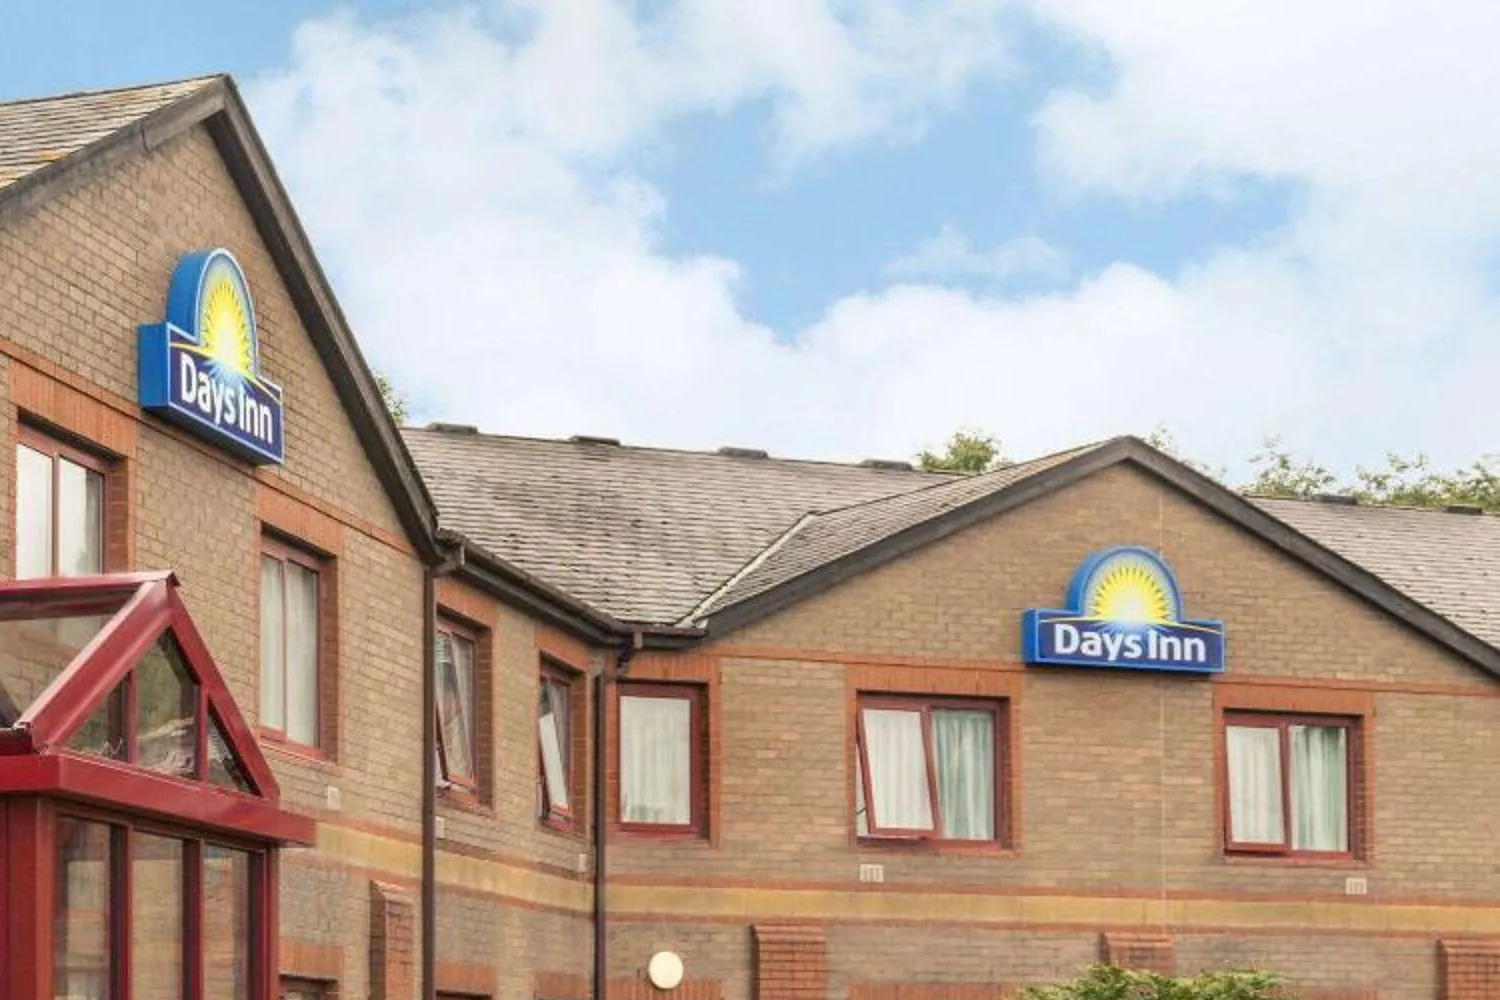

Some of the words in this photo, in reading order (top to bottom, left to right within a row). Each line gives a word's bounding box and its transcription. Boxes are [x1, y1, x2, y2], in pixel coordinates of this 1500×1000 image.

[179, 352, 235, 426] Days
[238, 383, 273, 444] Inn
[1053, 623, 1142, 662] Days
[1146, 630, 1207, 662] Inn
